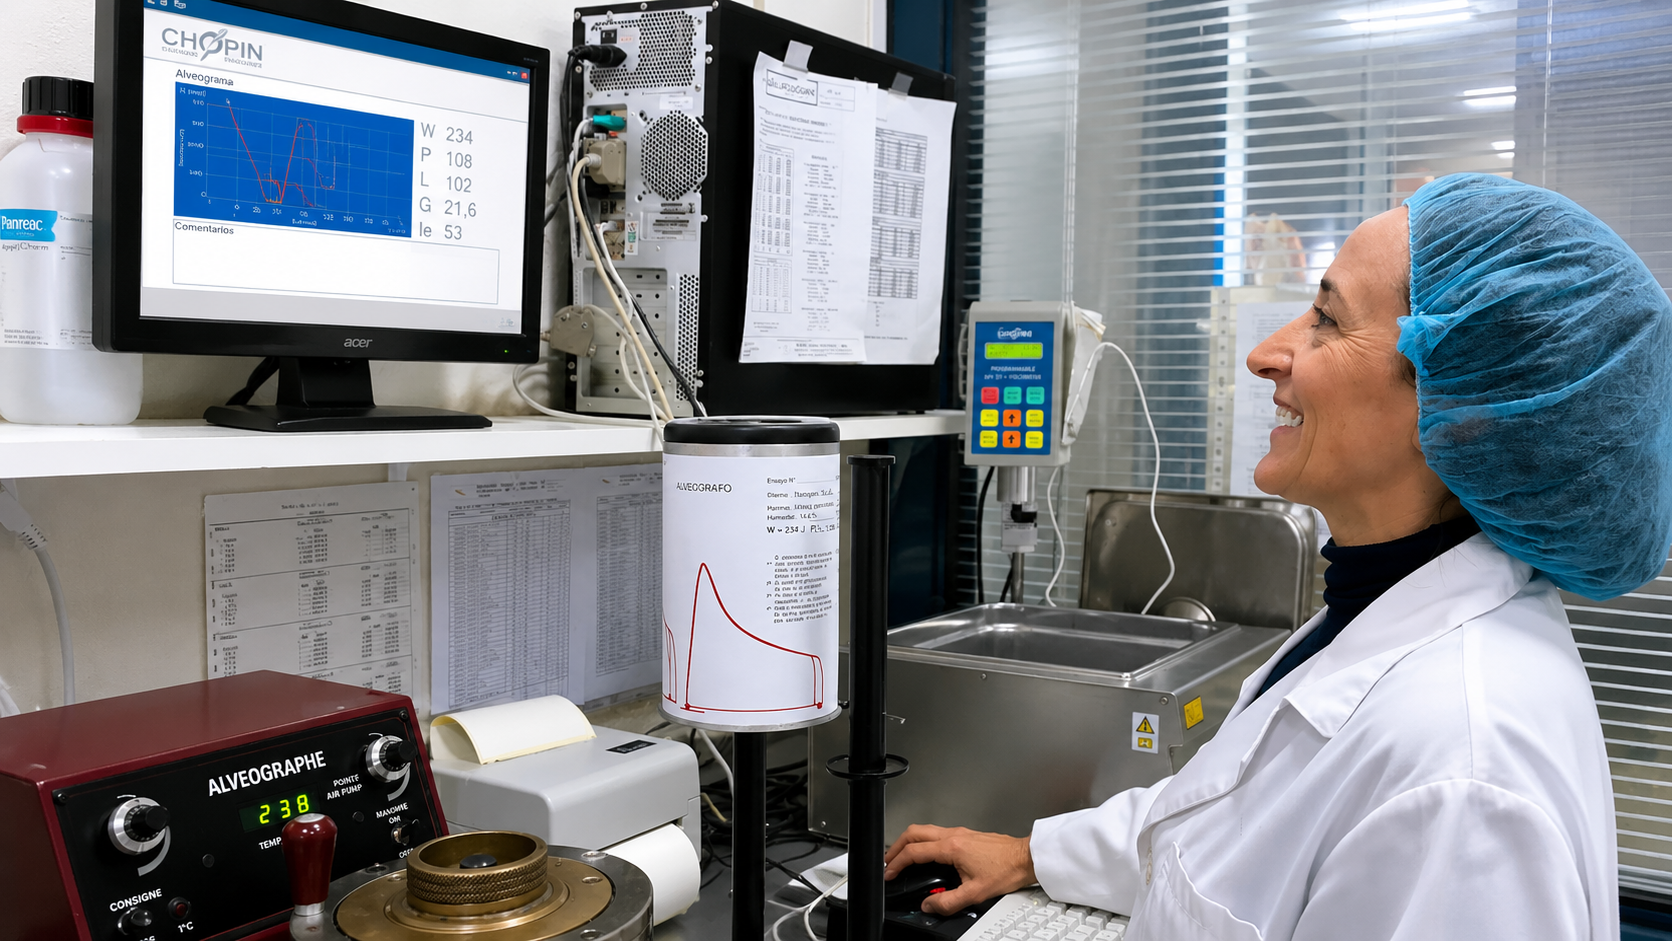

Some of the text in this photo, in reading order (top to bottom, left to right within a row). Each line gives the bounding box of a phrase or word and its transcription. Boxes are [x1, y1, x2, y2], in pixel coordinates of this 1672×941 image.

[162, 28, 262, 61] CHOPIN
[175, 69, 234, 86] Alveograma
[421, 122, 473, 145] W 234
[421, 147, 472, 169] P 108
[421, 171, 472, 193] L 102
[419, 196, 477, 219] G 21,6
[1, 215, 43, 231] Panreac
[444, 224, 462, 240] 53
[343, 338, 373, 348] acer
[676, 482, 732, 493] ALVEOGRAFO
[208, 751, 326, 796] ALVEOGRAPHE
[259, 794, 309, 824] 238
[109, 888, 162, 912] CONSIGNE
